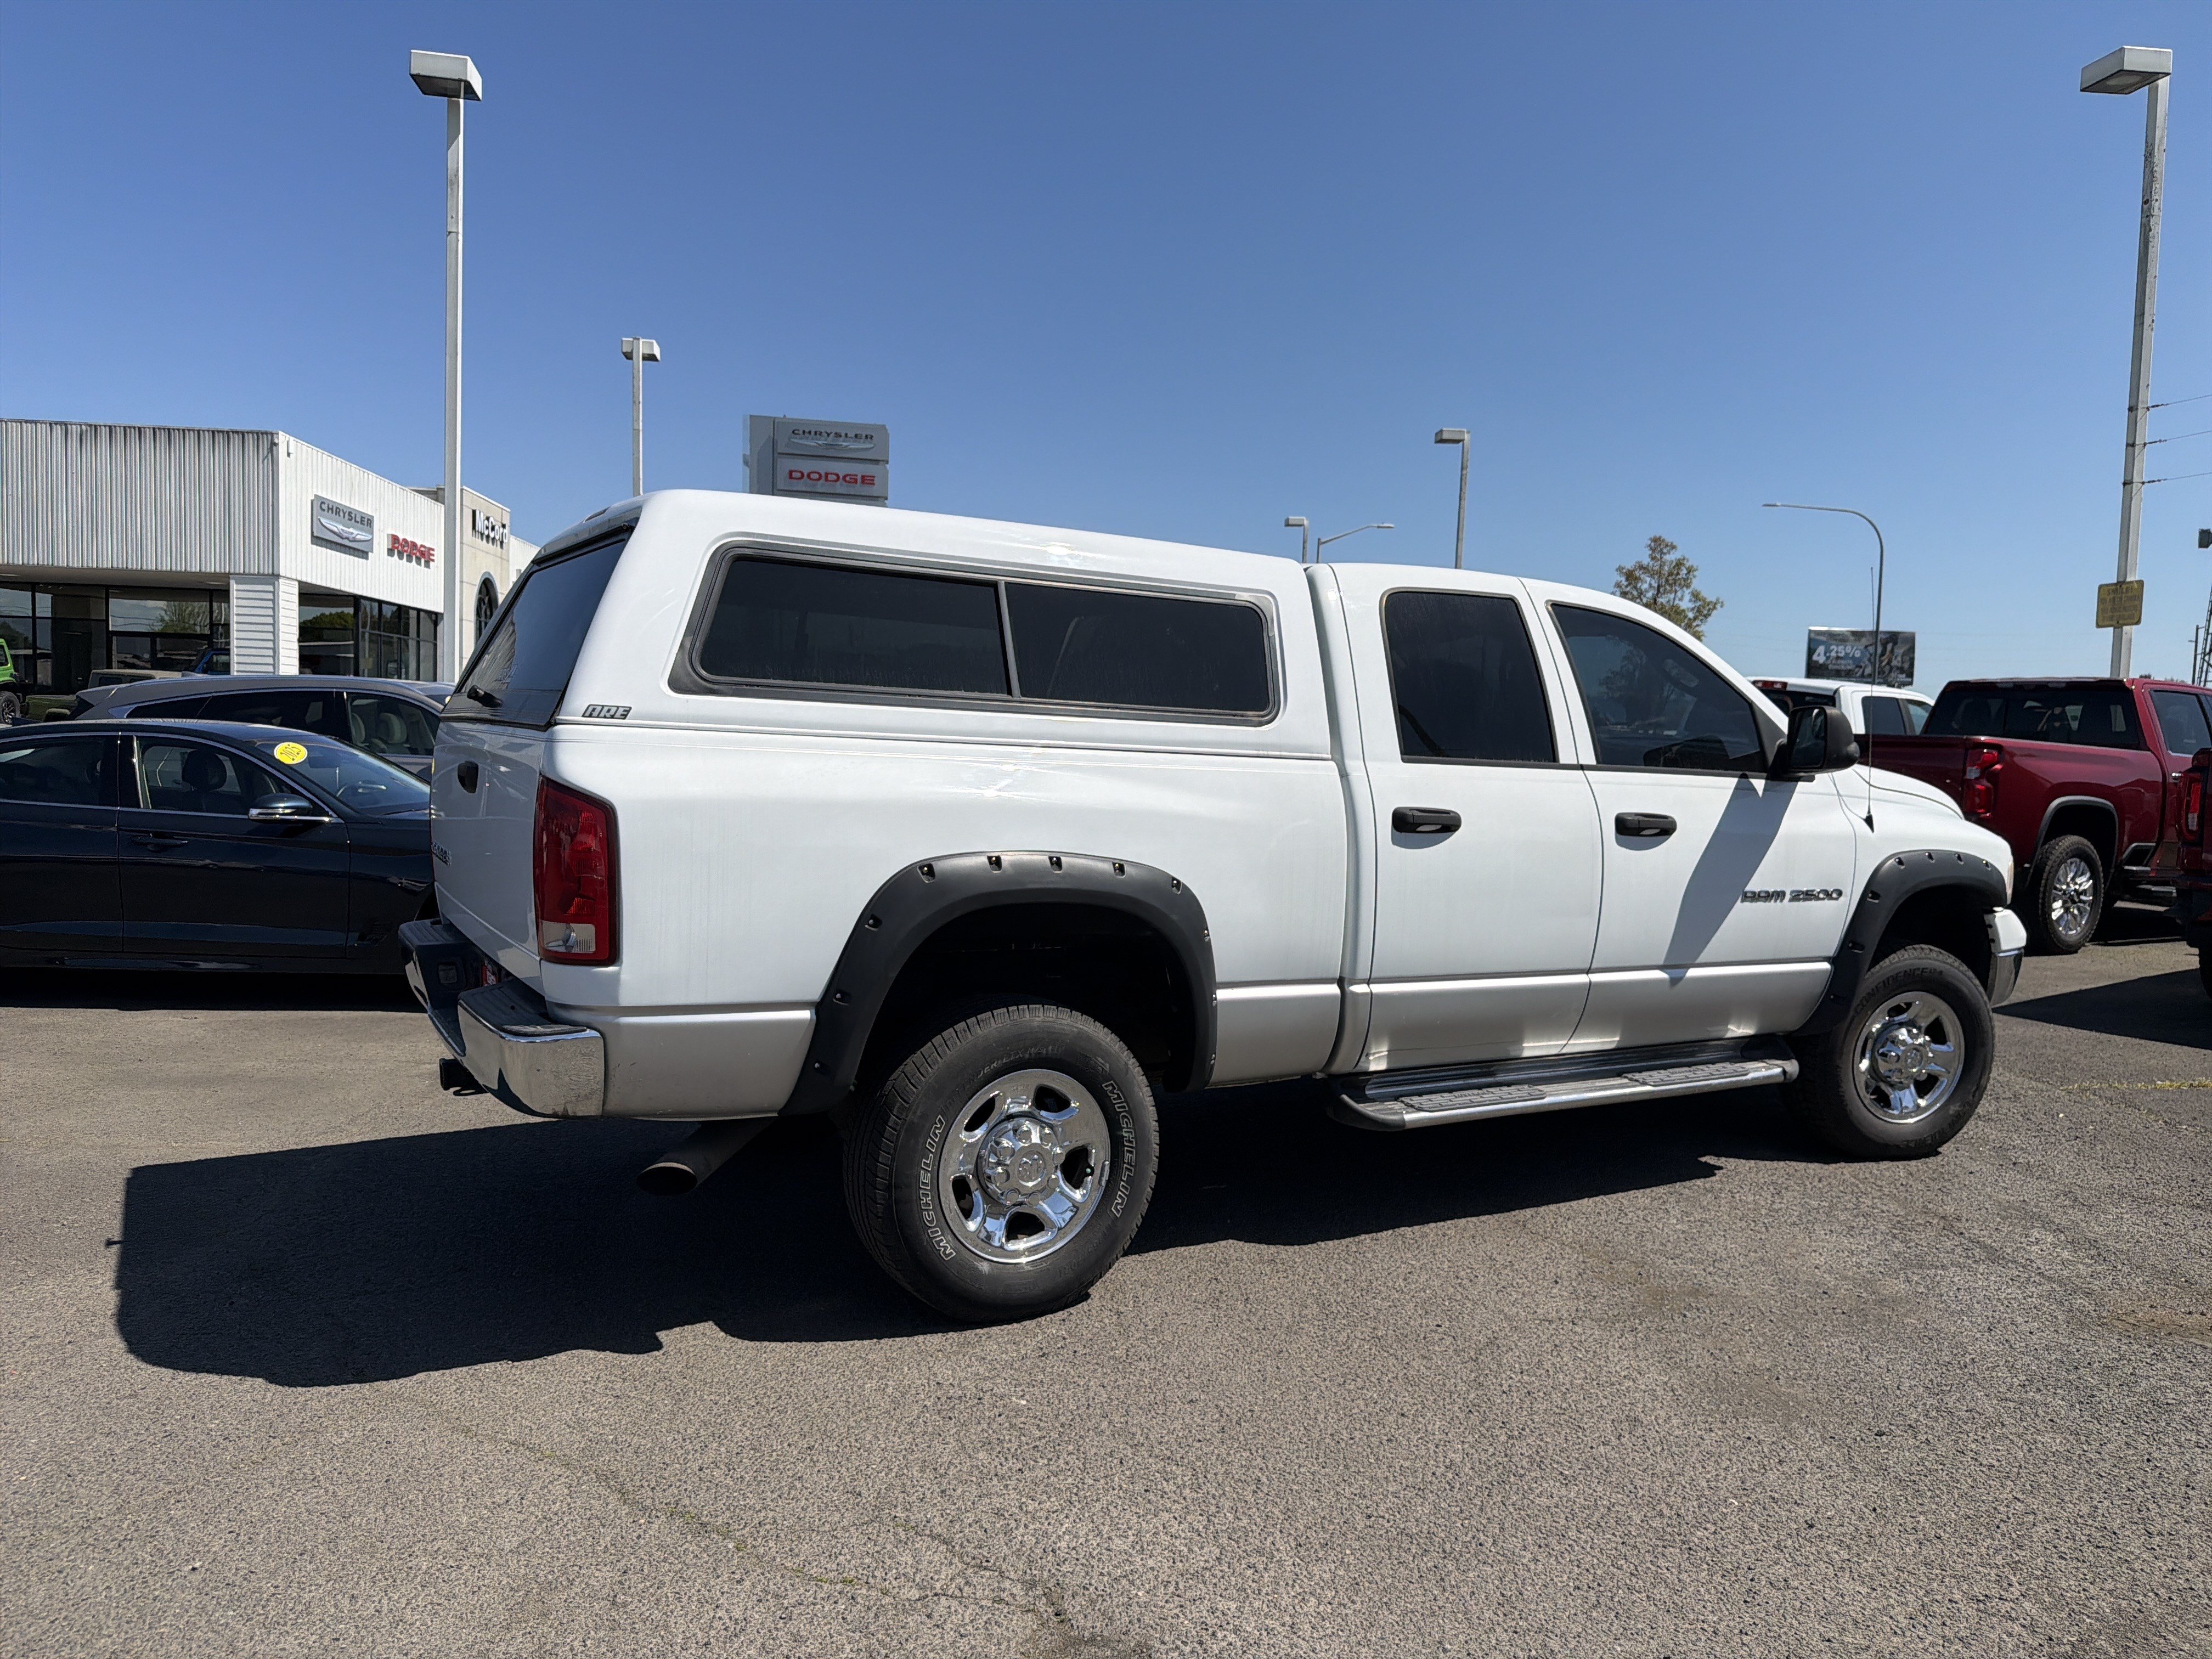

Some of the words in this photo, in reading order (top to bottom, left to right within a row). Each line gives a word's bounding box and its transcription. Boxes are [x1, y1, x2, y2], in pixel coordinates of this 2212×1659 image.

[791, 428, 874, 440] CHRYSLER
[788, 469, 876, 486] DODGE
[319, 501, 373, 528] CHRYSLER
[474, 509, 508, 543] McCord
[390, 534, 435, 562] DODGE
[1812, 645, 1861, 664] 4.25%
[584, 705, 630, 718] ARE
[1741, 889, 1786, 903] RAM
[1788, 888, 1843, 902] 2500
[1102, 1080, 1136, 1217] MICHELIN
[919, 1114, 956, 1261] MICHELIN
